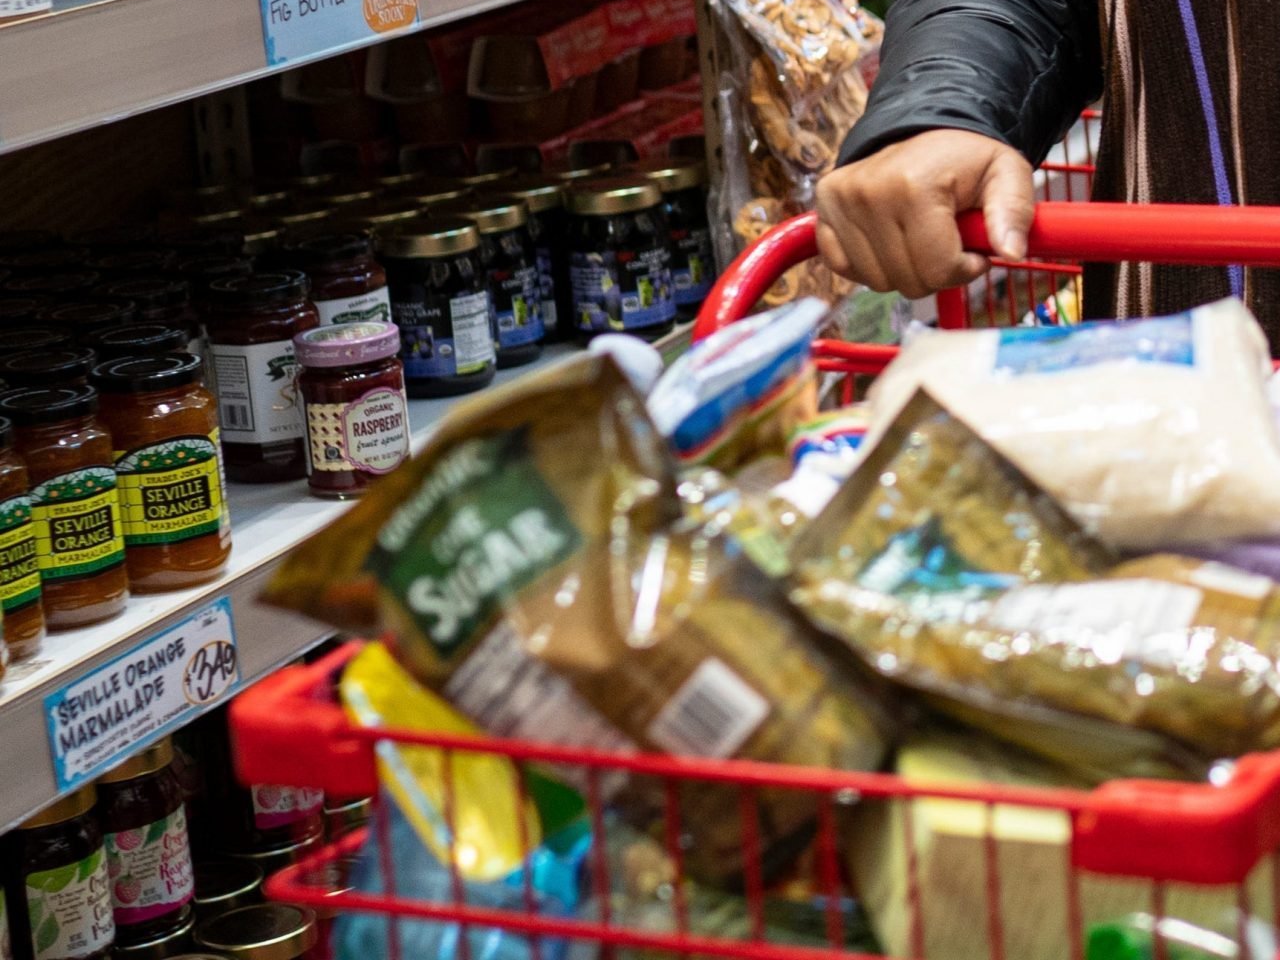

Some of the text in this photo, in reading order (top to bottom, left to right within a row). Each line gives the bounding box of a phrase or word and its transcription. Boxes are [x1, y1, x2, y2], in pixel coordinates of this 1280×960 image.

[378, 4, 407, 26] SOON
[363, 402, 395, 417] ORGANIC
[351, 413, 403, 438] RASPBERRY
[146, 479, 204, 503] SEVILLE
[147, 496, 206, 518] ORANGE
[54, 509, 109, 535] SEVILLE
[150, 512, 208, 529] MARMALADE
[55, 525, 111, 551] ORANGE
[0, 539, 37, 566] EVILLE
[57, 543, 114, 565] MARMALADE
[0, 555, 39, 582] RANGE
[57, 636, 187, 728] SEVILLE ORANGE
[59, 674, 165, 755] MARMALADE
